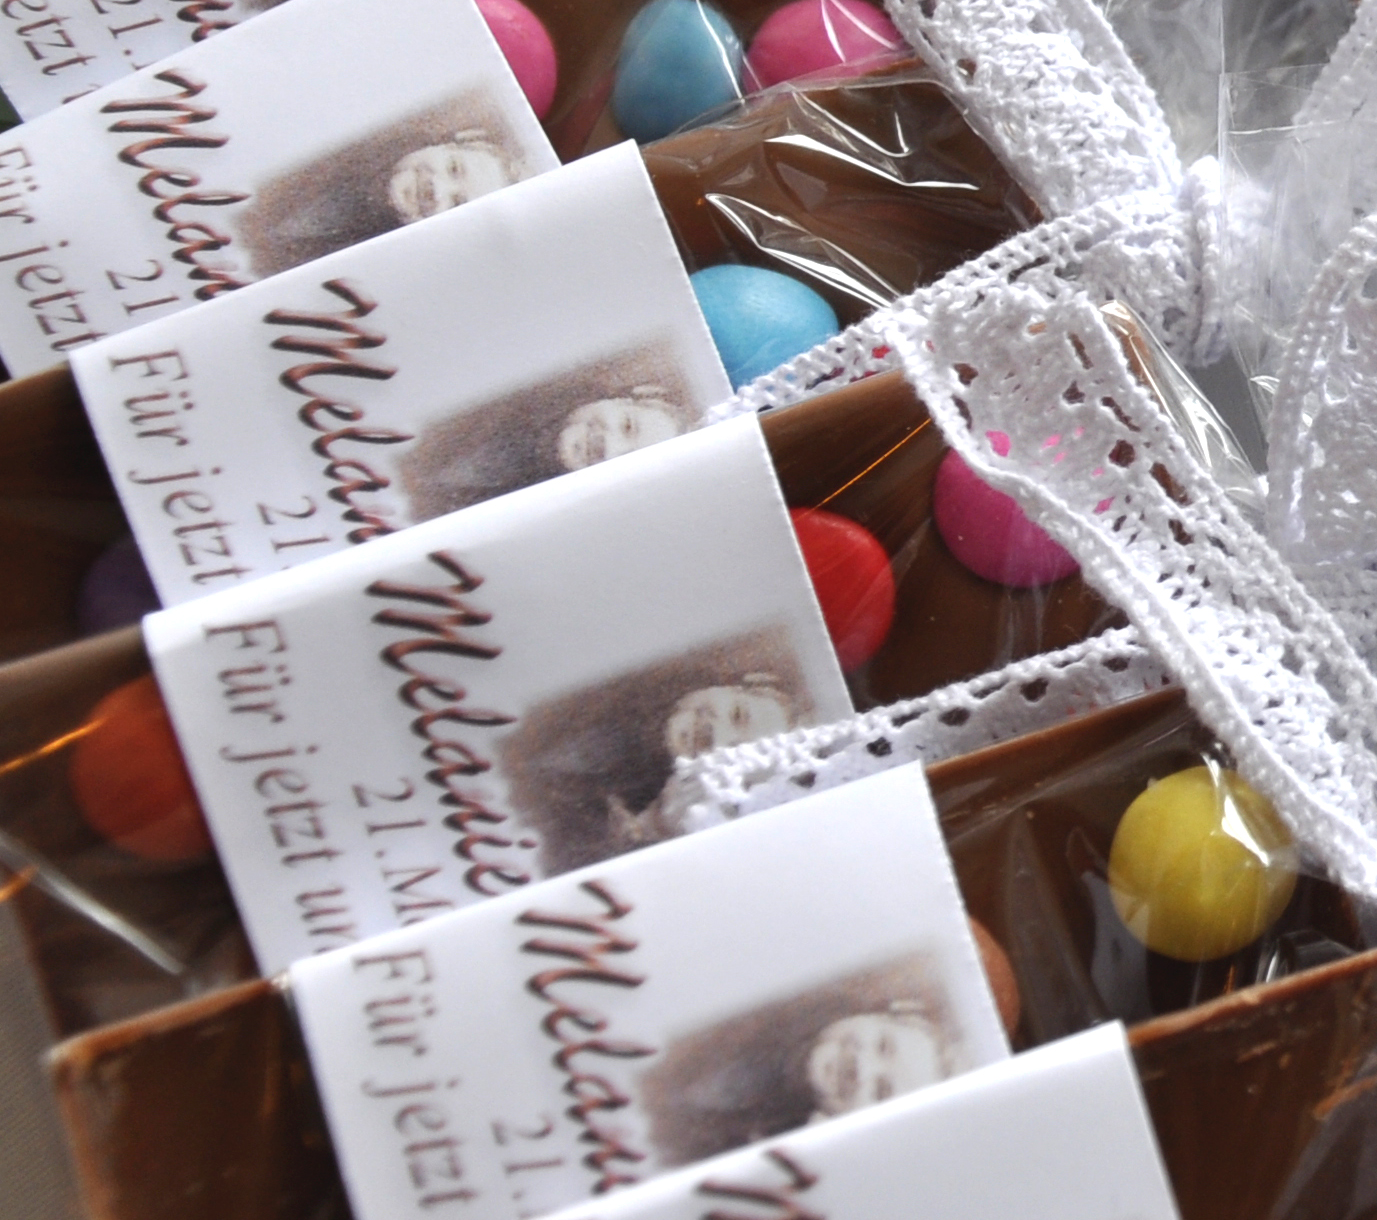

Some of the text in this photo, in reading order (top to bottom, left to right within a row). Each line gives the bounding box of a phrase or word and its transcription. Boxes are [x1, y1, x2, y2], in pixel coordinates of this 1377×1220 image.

[108, 348, 252, 587] Für jetzt
[204, 619, 292, 724] Für
[219, 743, 344, 868] jetzt
[352, 779, 454, 924] 21.M
[352, 948, 477, 1211] Für jetzt
[490, 1114, 563, 1212] 21.
